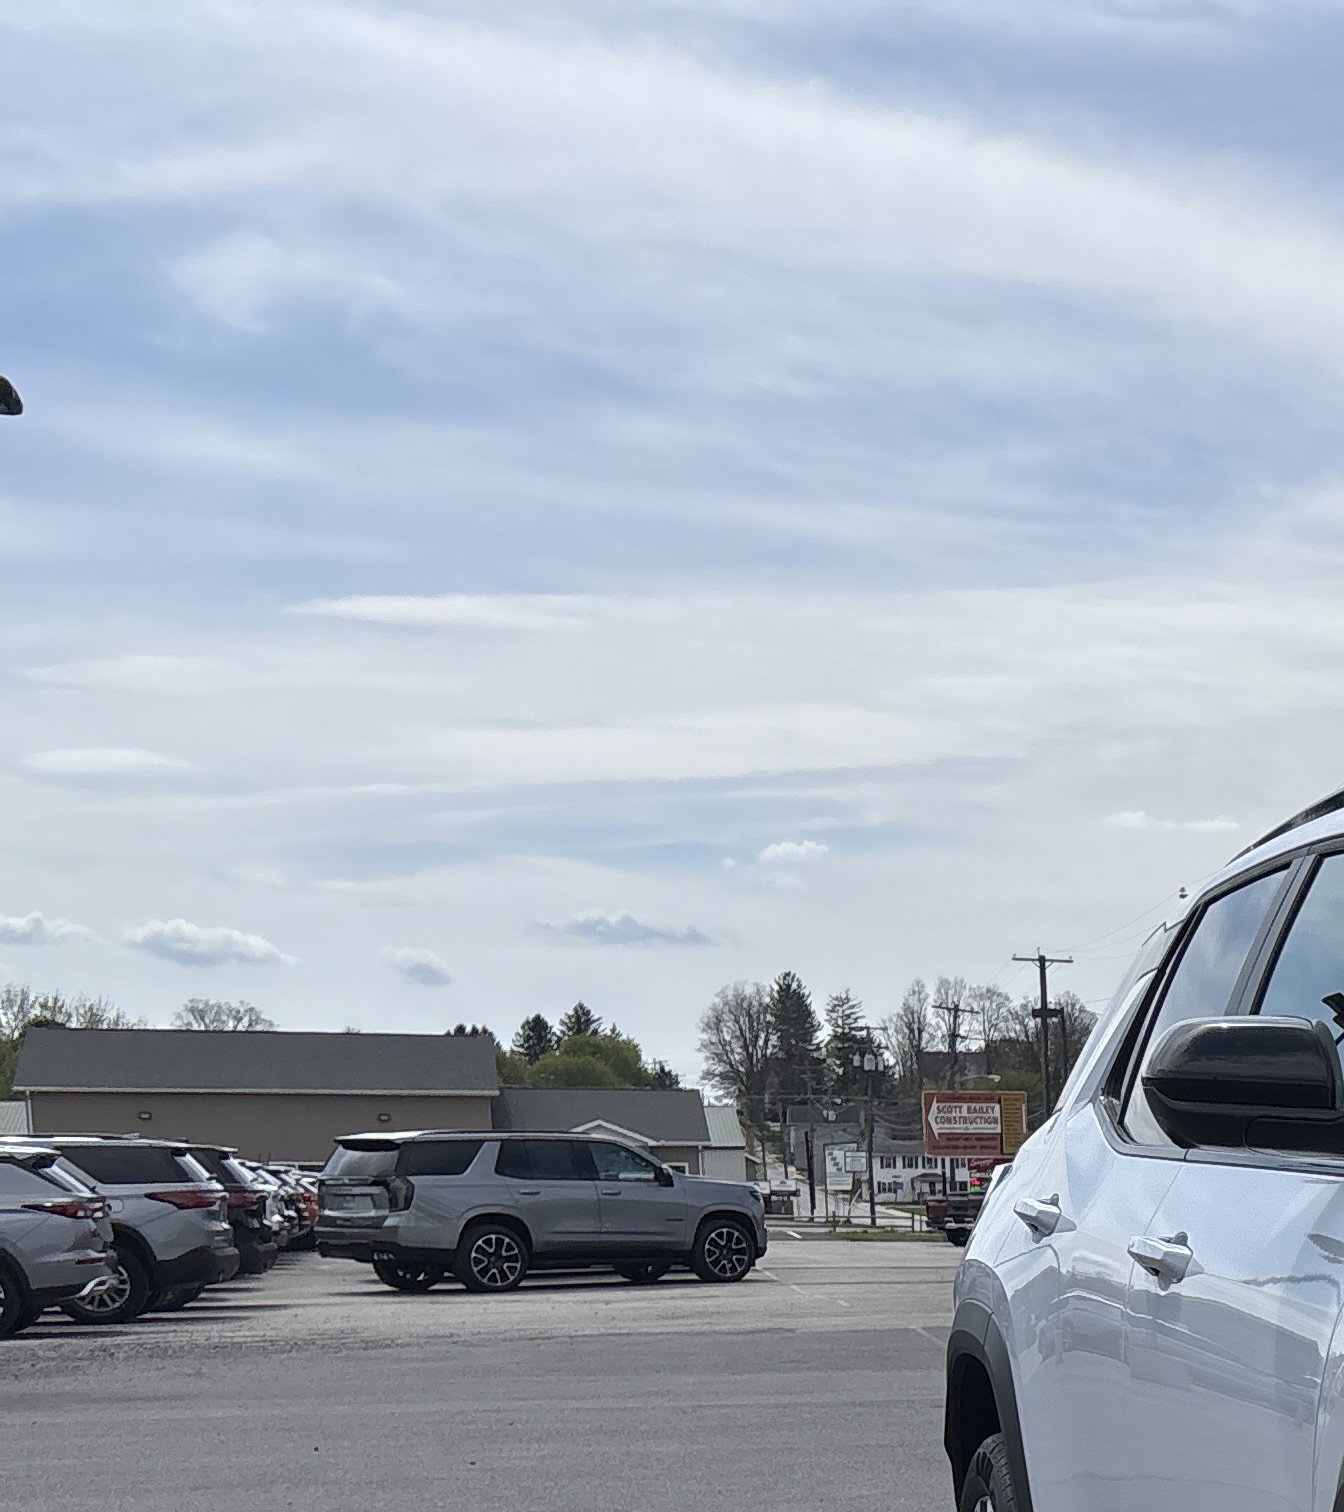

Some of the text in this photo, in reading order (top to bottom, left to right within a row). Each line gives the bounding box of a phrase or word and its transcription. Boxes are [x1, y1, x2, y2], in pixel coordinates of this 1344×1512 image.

[936, 1104, 996, 1115] SCOTT BAILEY
[934, 1115, 999, 1126] CONSTRUCTION
